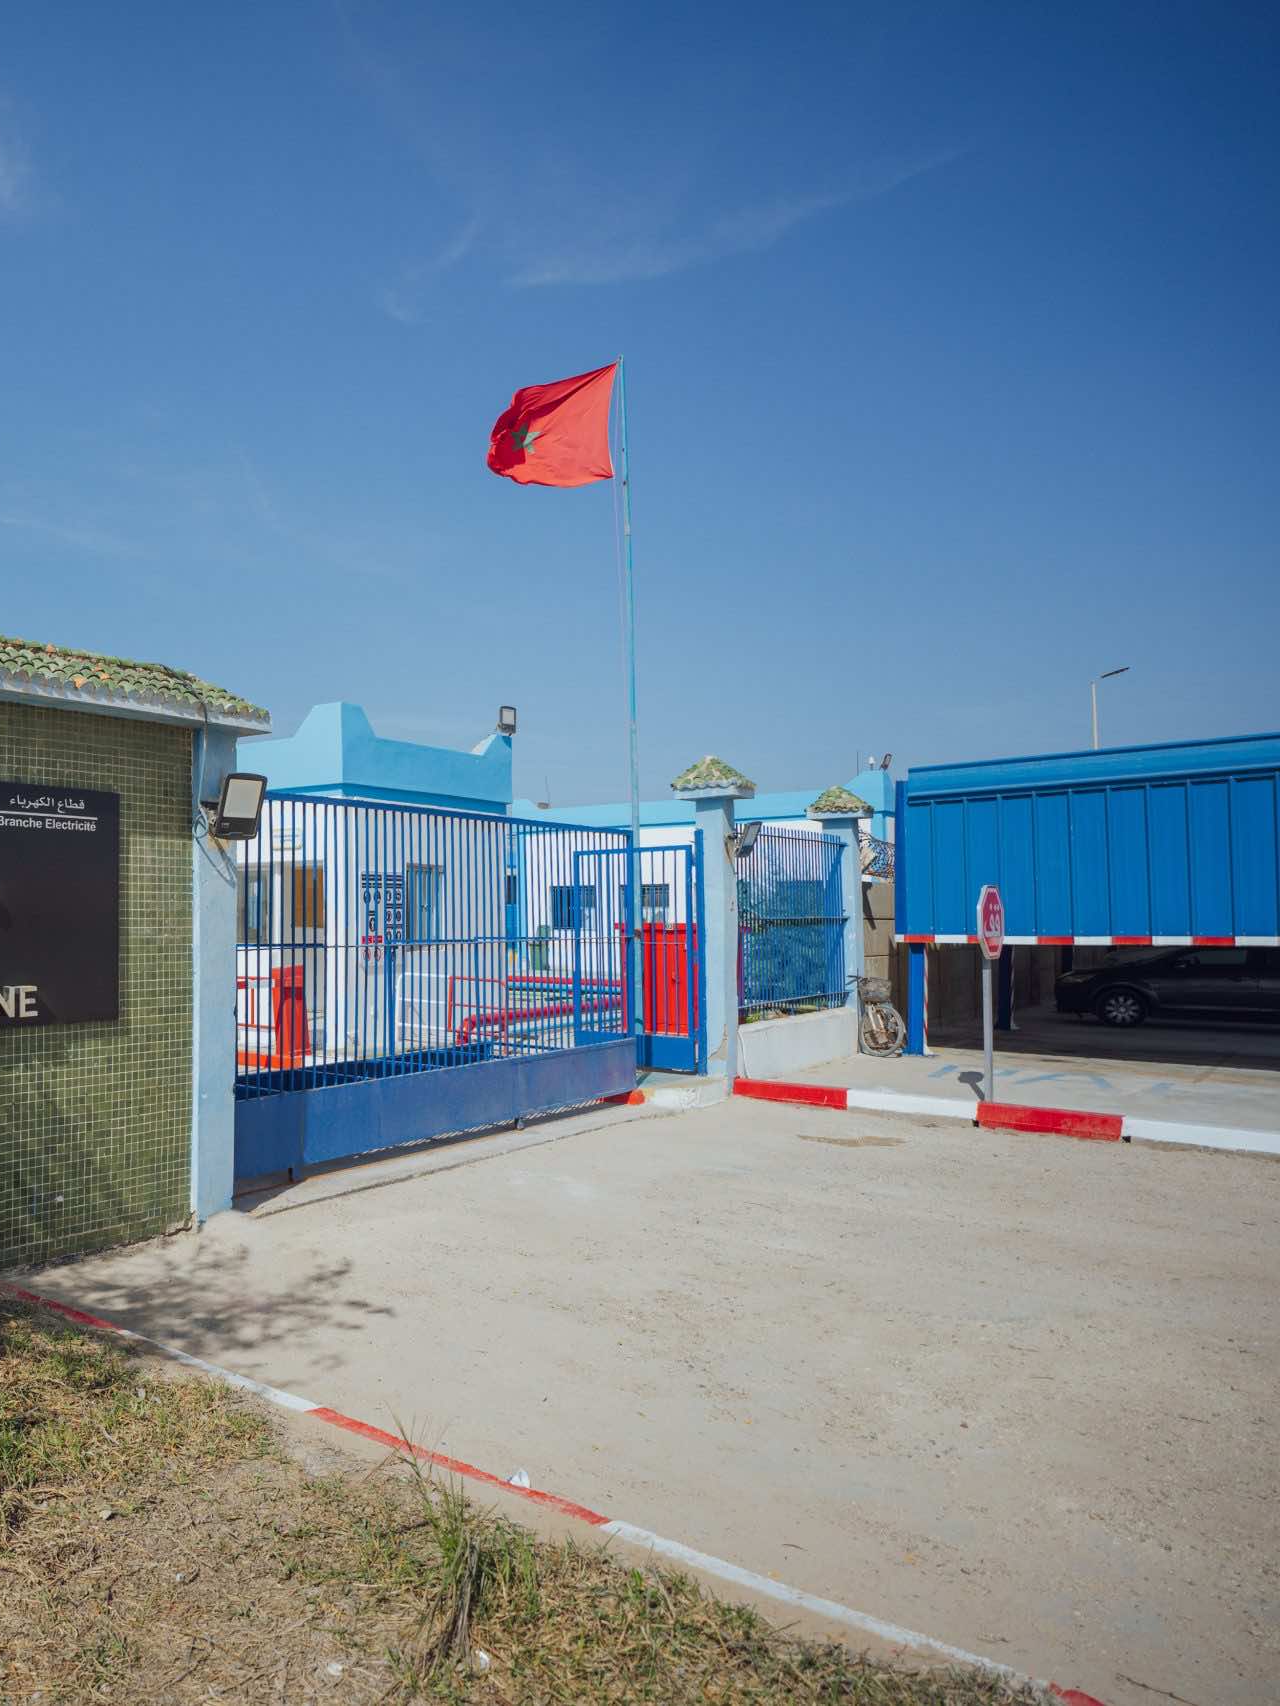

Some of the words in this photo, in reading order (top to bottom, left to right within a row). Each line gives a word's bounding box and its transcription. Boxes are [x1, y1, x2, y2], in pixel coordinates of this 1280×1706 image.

[9, 794, 56, 809] الكهرباء
[57, 798, 85, 814] قطاع
[45, 818, 97, 832] Electricité
